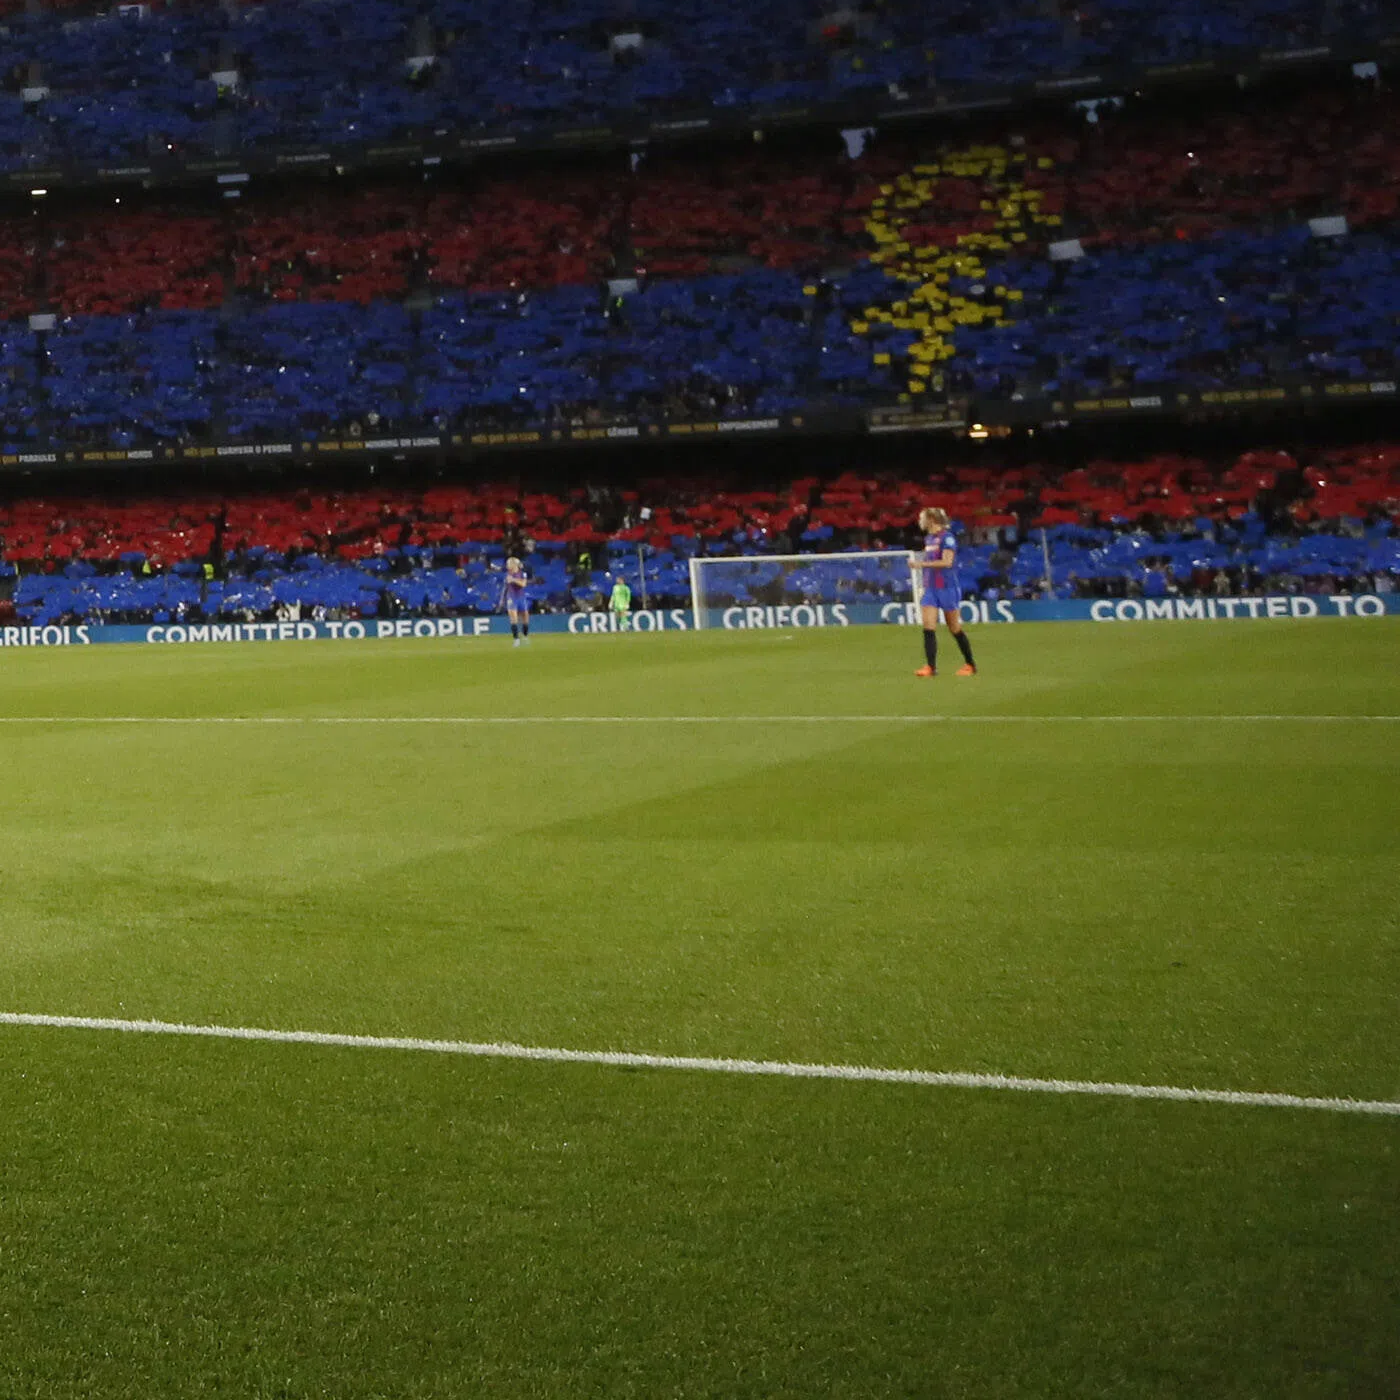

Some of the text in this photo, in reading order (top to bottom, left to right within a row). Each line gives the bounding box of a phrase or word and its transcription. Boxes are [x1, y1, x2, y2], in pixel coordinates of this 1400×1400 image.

[723, 604, 849, 630] GRIFOLS
[1091, 595, 1385, 622] COMMITTED TO
[146, 618, 490, 644] COMMITTED TO PEOPLE
